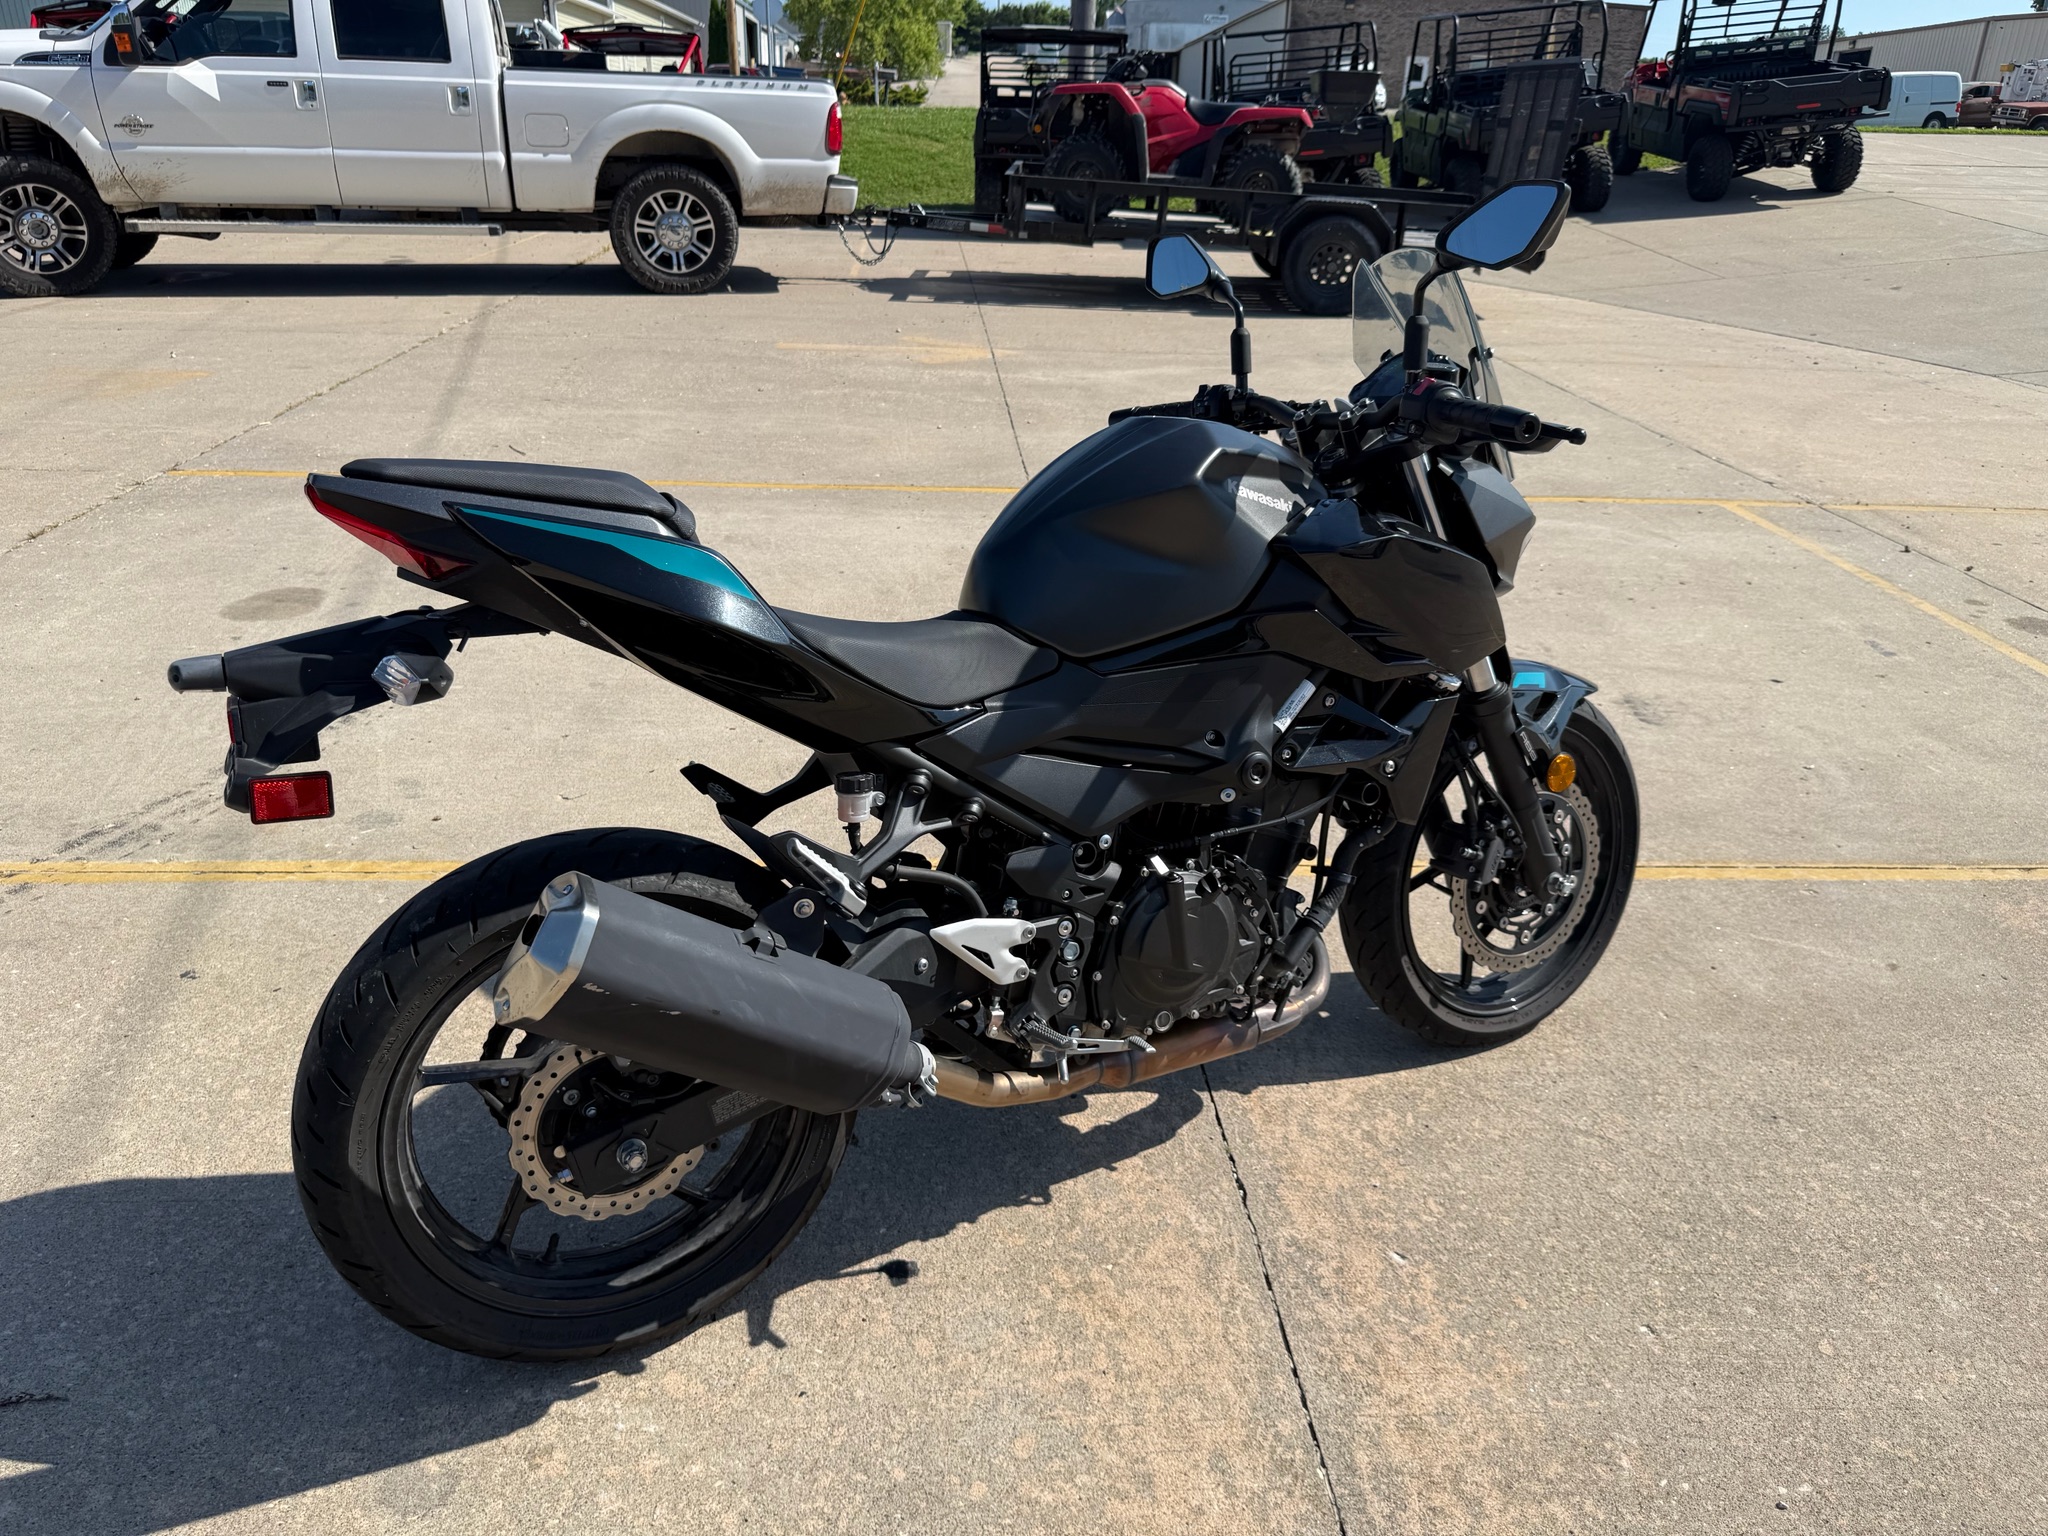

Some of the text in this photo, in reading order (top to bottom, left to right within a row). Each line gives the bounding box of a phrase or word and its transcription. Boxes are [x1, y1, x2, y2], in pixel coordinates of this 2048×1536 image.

[696, 80, 809, 91] PLATINUM
[1227, 478, 1293, 513] Kawasaki
[1520, 731, 1537, 762] ABS
